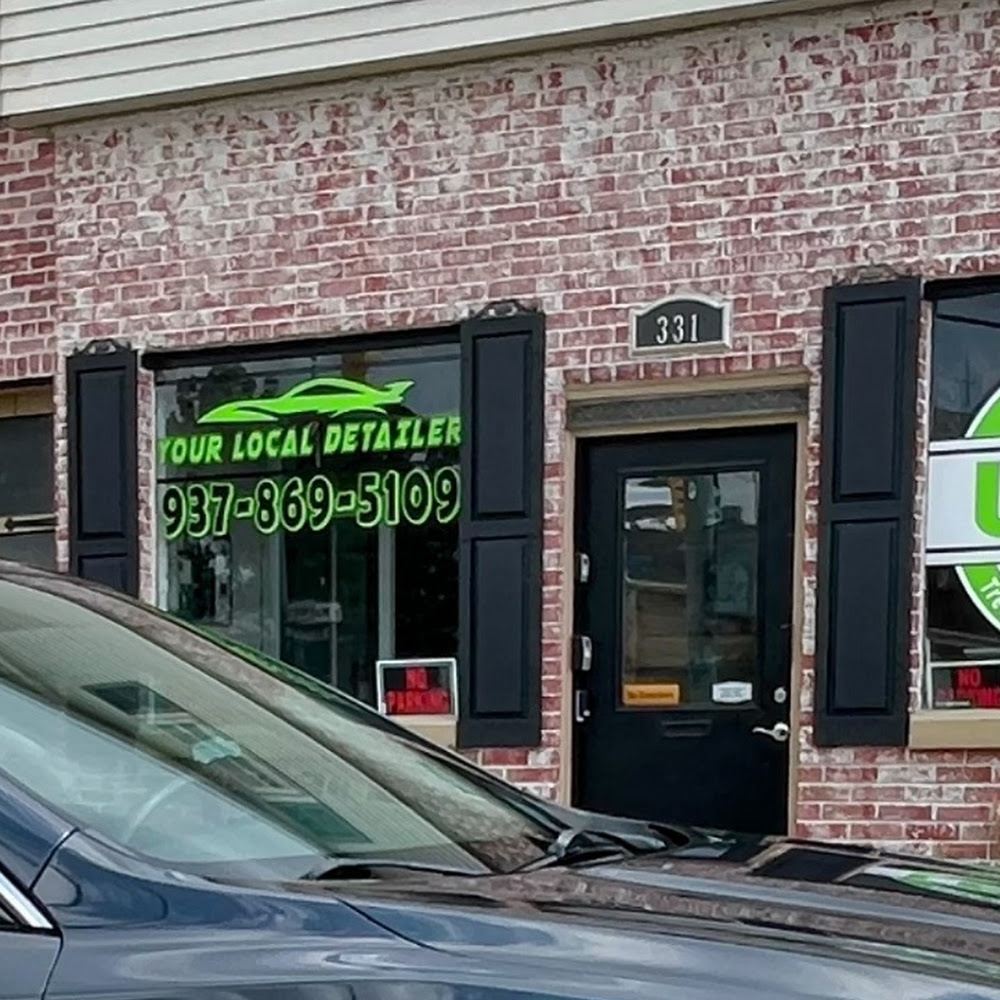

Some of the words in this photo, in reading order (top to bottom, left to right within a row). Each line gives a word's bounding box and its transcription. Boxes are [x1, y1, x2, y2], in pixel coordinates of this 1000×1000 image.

[656, 314, 698, 344] 331
[159, 433, 223, 465] YOUR
[231, 424, 314, 461] LOCAL
[323, 415, 461, 456] DETAILER
[162, 465, 461, 540] 937-869-5109
